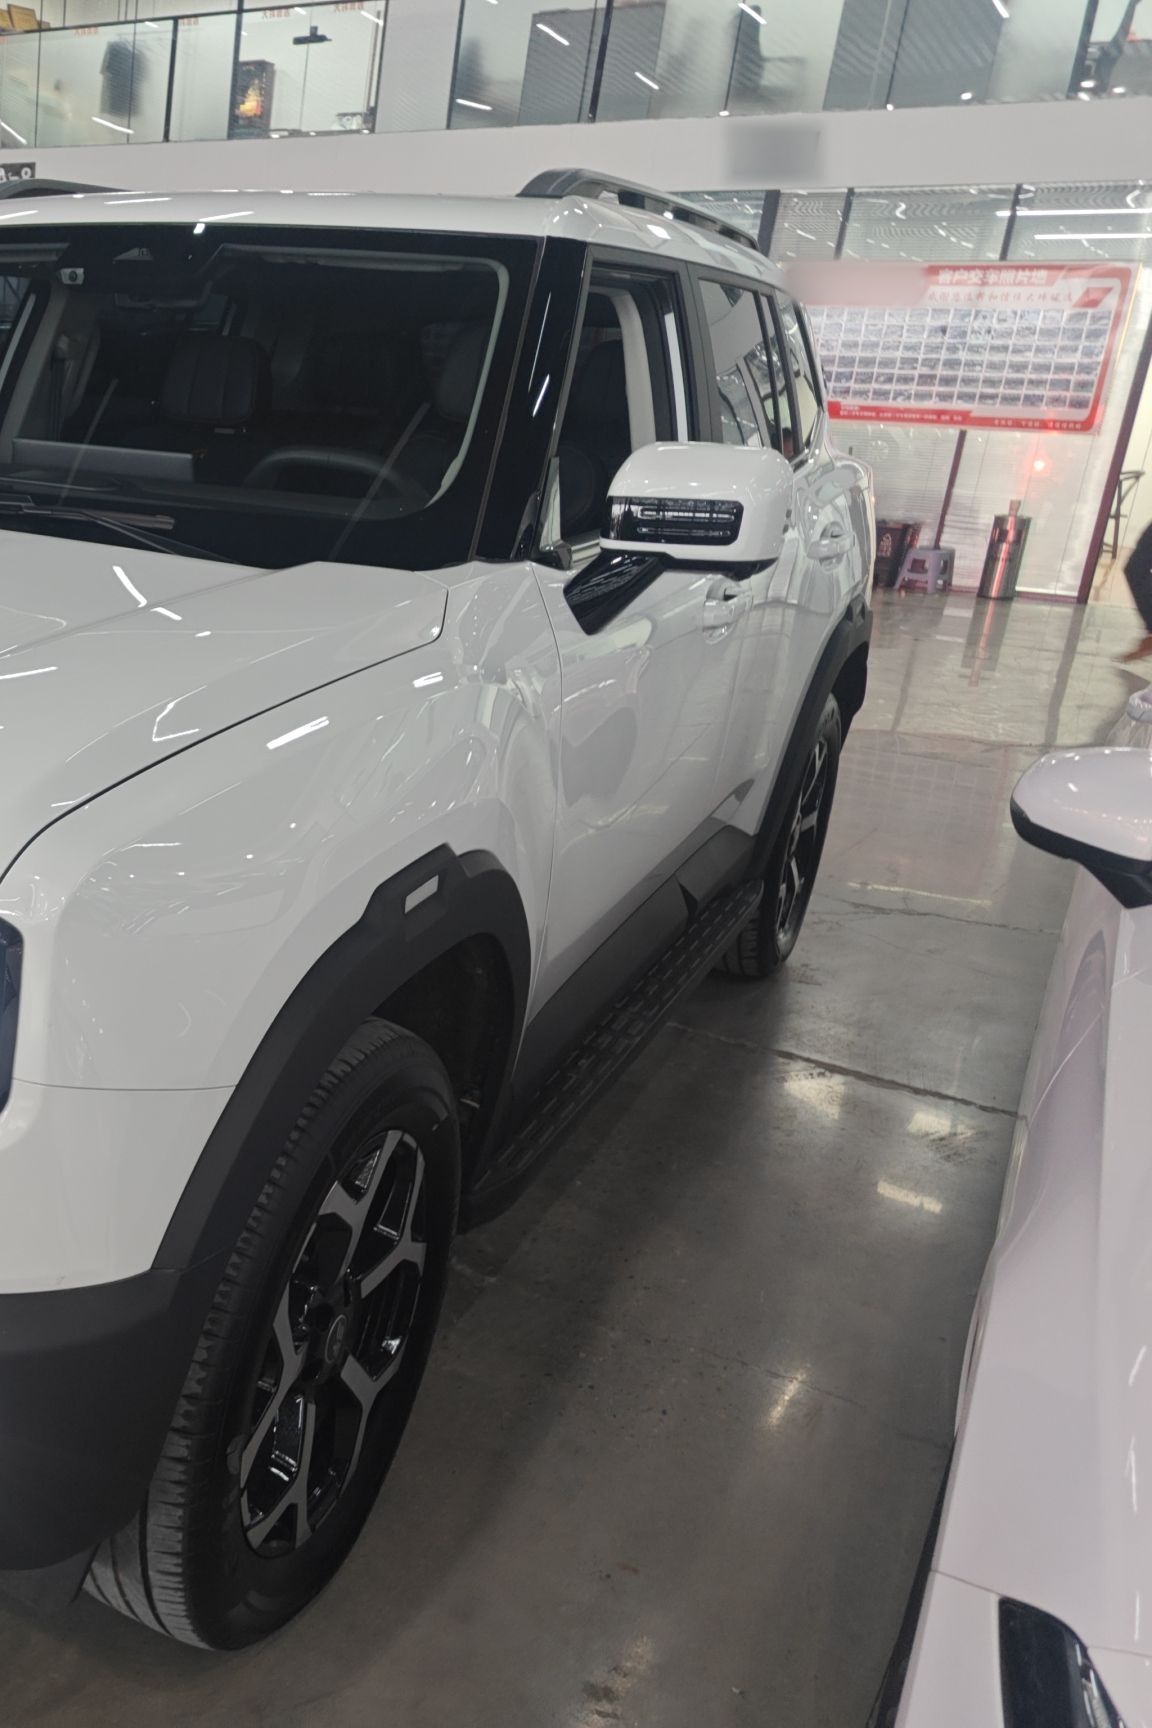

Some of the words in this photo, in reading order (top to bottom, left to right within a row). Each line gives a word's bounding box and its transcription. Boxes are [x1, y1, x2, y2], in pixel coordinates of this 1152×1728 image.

[938, 268, 1048, 286] 客户交车照片墙
